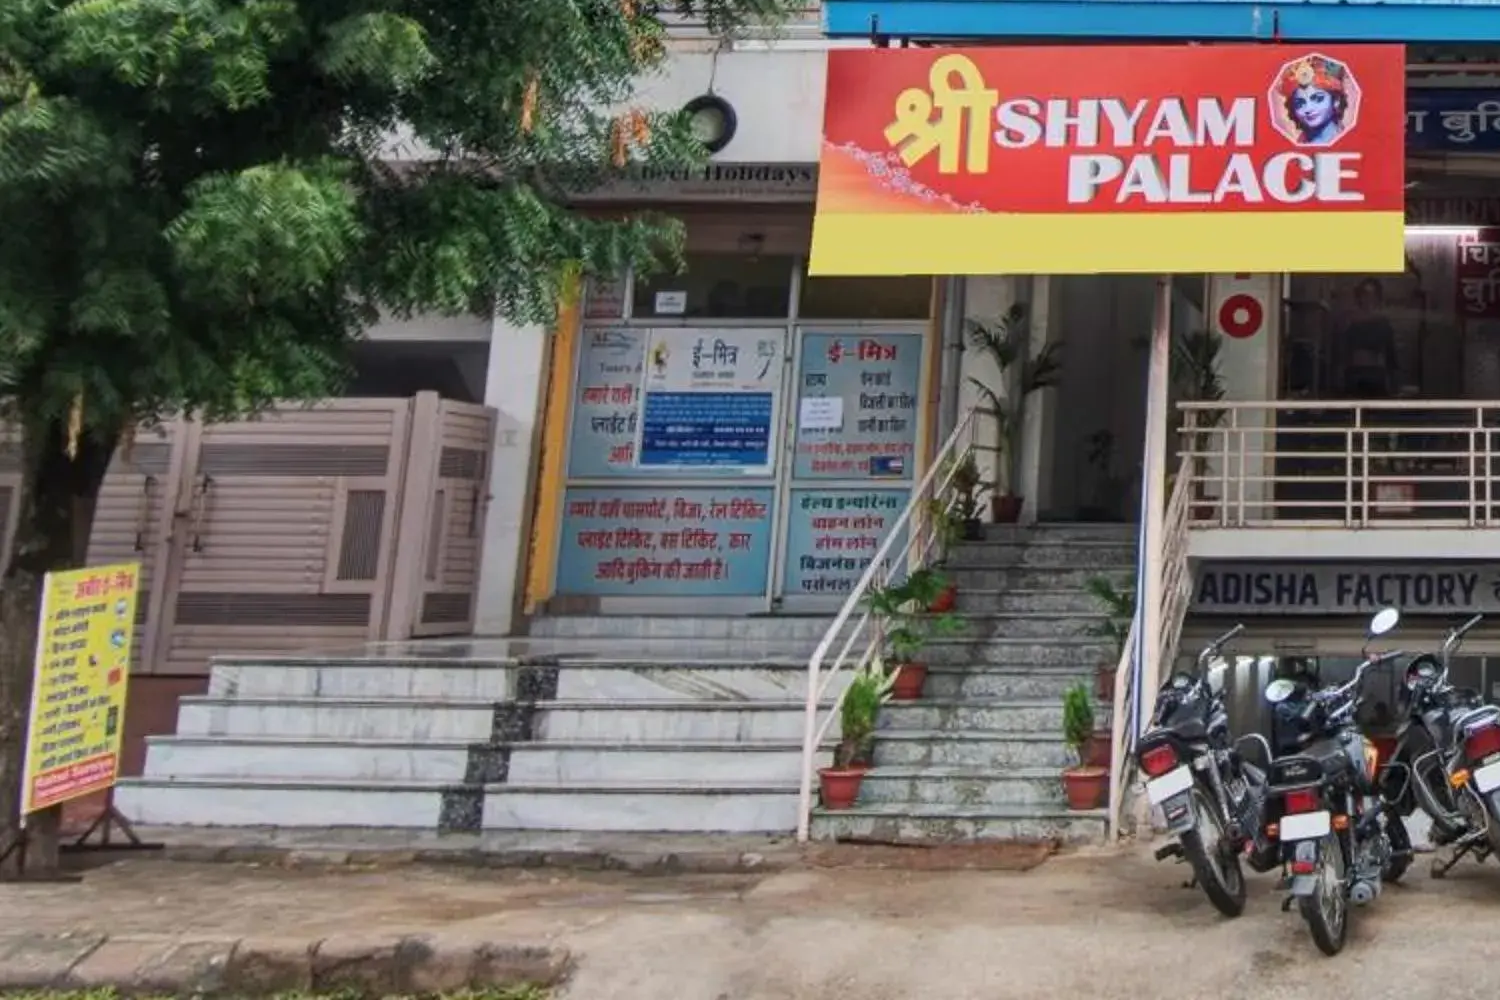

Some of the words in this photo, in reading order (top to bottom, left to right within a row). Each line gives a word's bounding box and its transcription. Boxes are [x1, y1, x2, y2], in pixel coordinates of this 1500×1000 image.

[883, 53, 999, 175] श्री
[995, 97, 1255, 148] SHYAM
[703, 163, 812, 187] Holidays
[1068, 152, 1364, 204] PALACE
[1198, 572, 1320, 605] ADISHA
[1335, 572, 1479, 606] FACTORY
